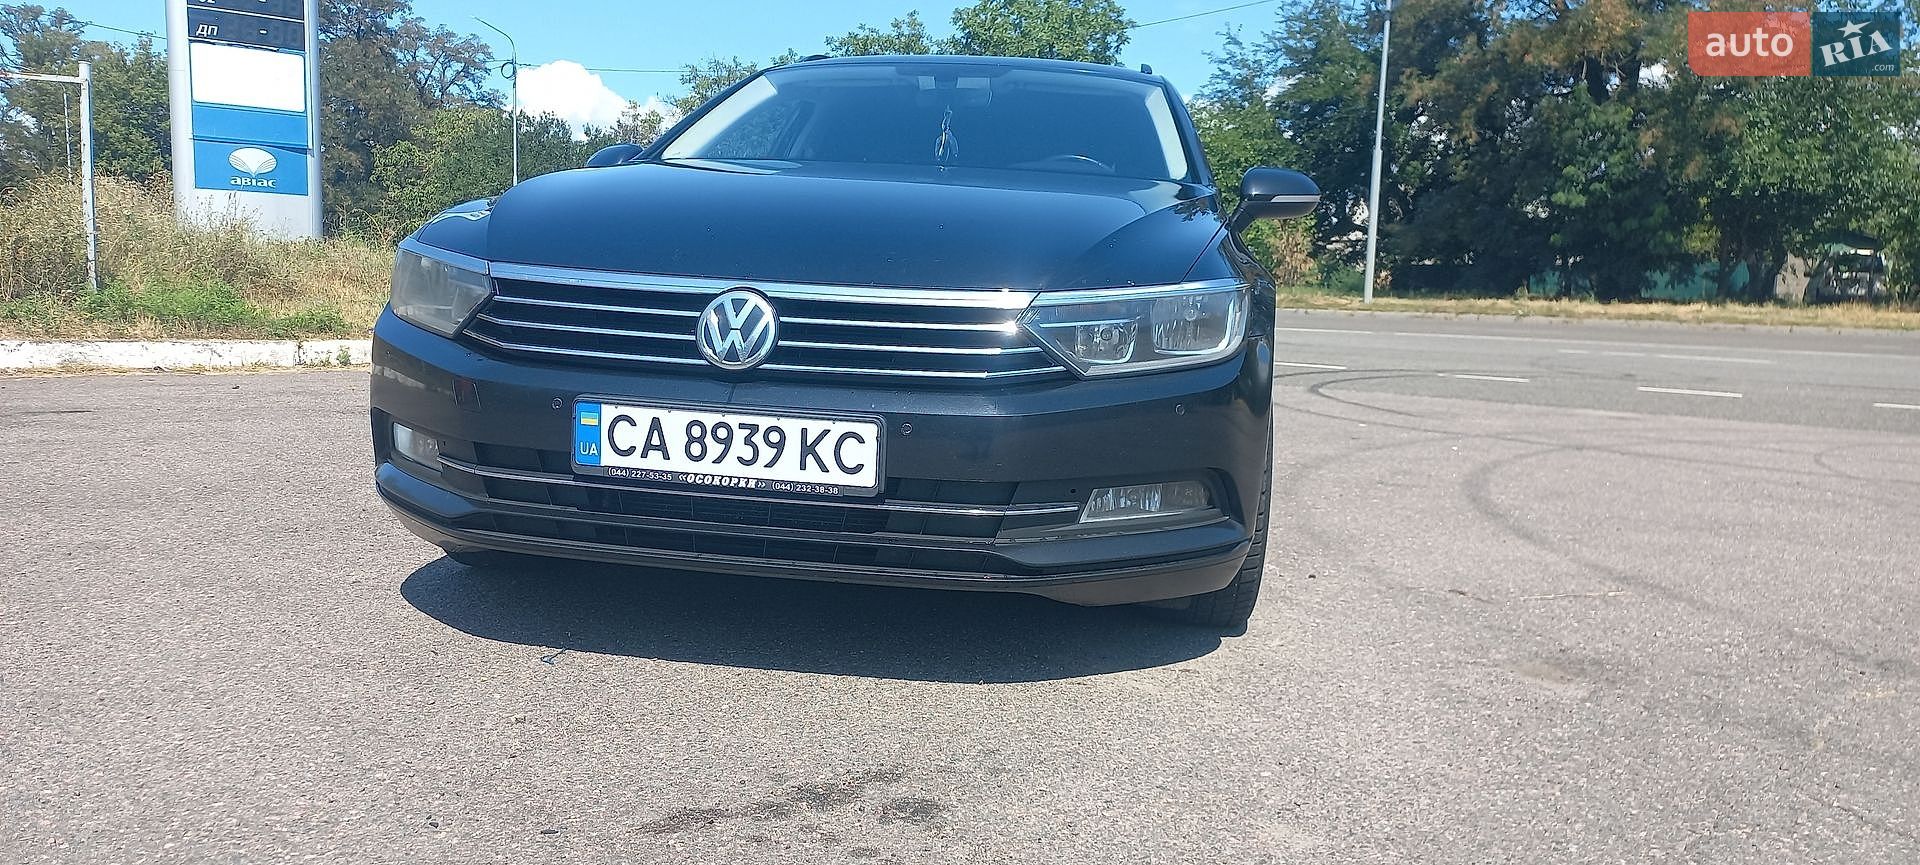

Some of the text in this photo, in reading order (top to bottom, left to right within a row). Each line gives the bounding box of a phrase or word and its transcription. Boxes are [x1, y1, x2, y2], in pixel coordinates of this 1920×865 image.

[196, 24, 219, 37] ДП
[580, 441, 599, 457] UA
[607, 414, 866, 475] CA 8939 KC
[608, 467, 630, 478] (044)
[631, 469, 673, 481] 227-53-35
[771, 481, 795, 493] (044)
[795, 483, 840, 495] 232-38-38
